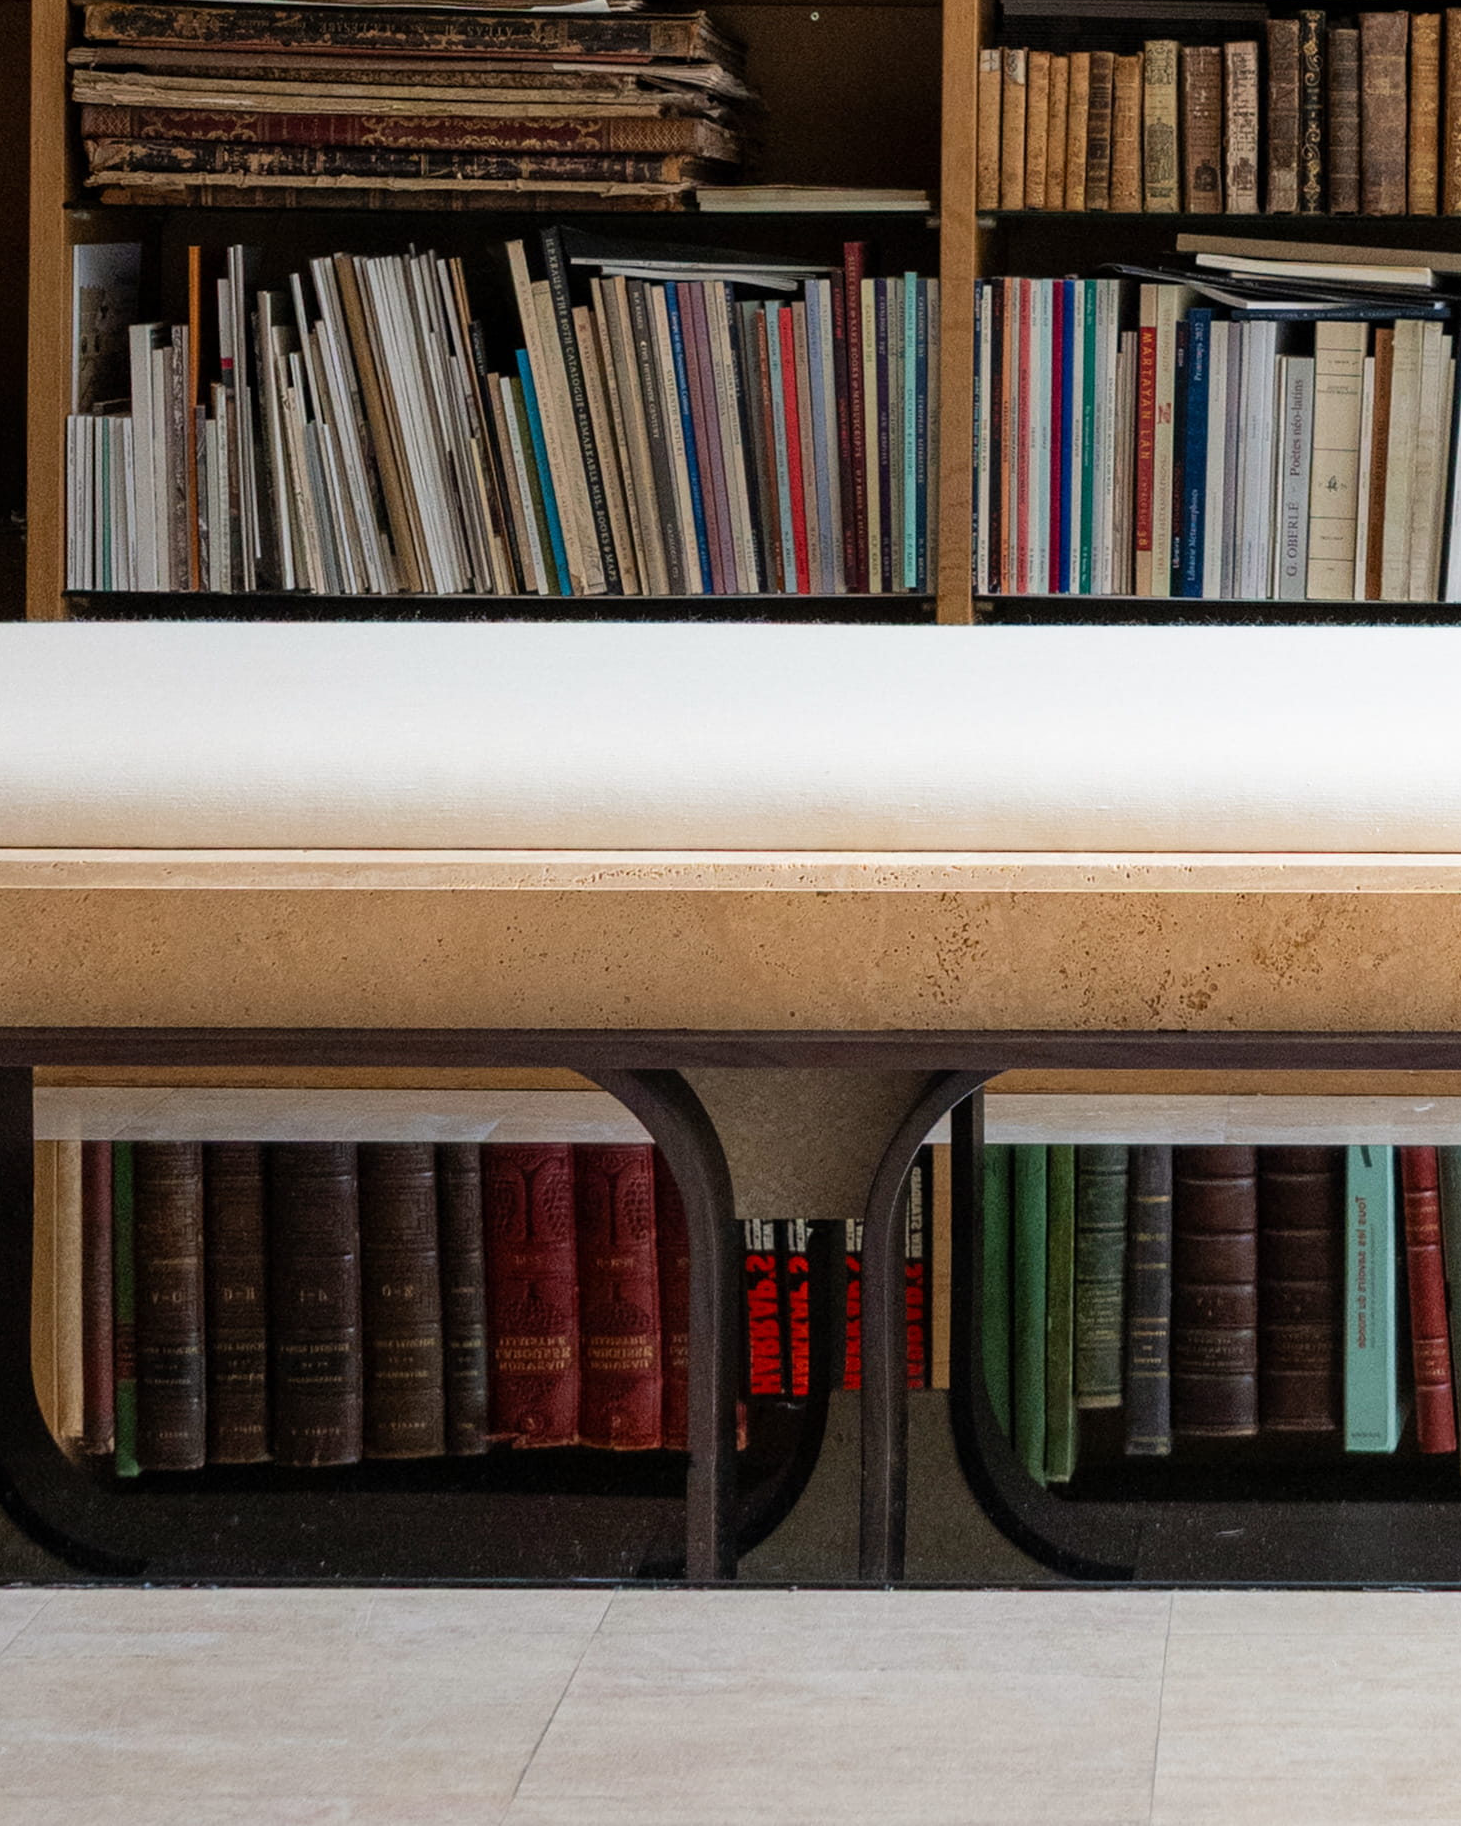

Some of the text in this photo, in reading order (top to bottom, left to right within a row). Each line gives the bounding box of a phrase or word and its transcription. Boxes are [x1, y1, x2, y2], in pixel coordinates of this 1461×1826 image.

[1141, 332, 1153, 420] MARTAYAN
[1290, 379, 1304, 435] néo-latins
[564, 346, 585, 409] CATALOGUE
[577, 413, 601, 483] REMARKABLE
[594, 510, 610, 543] BOOKS
[603, 553, 619, 582] MAPS
[1141, 428, 1152, 460] LAN
[1289, 438, 1302, 477] Poètes
[1284, 501, 1299, 559] OBERLÉ
